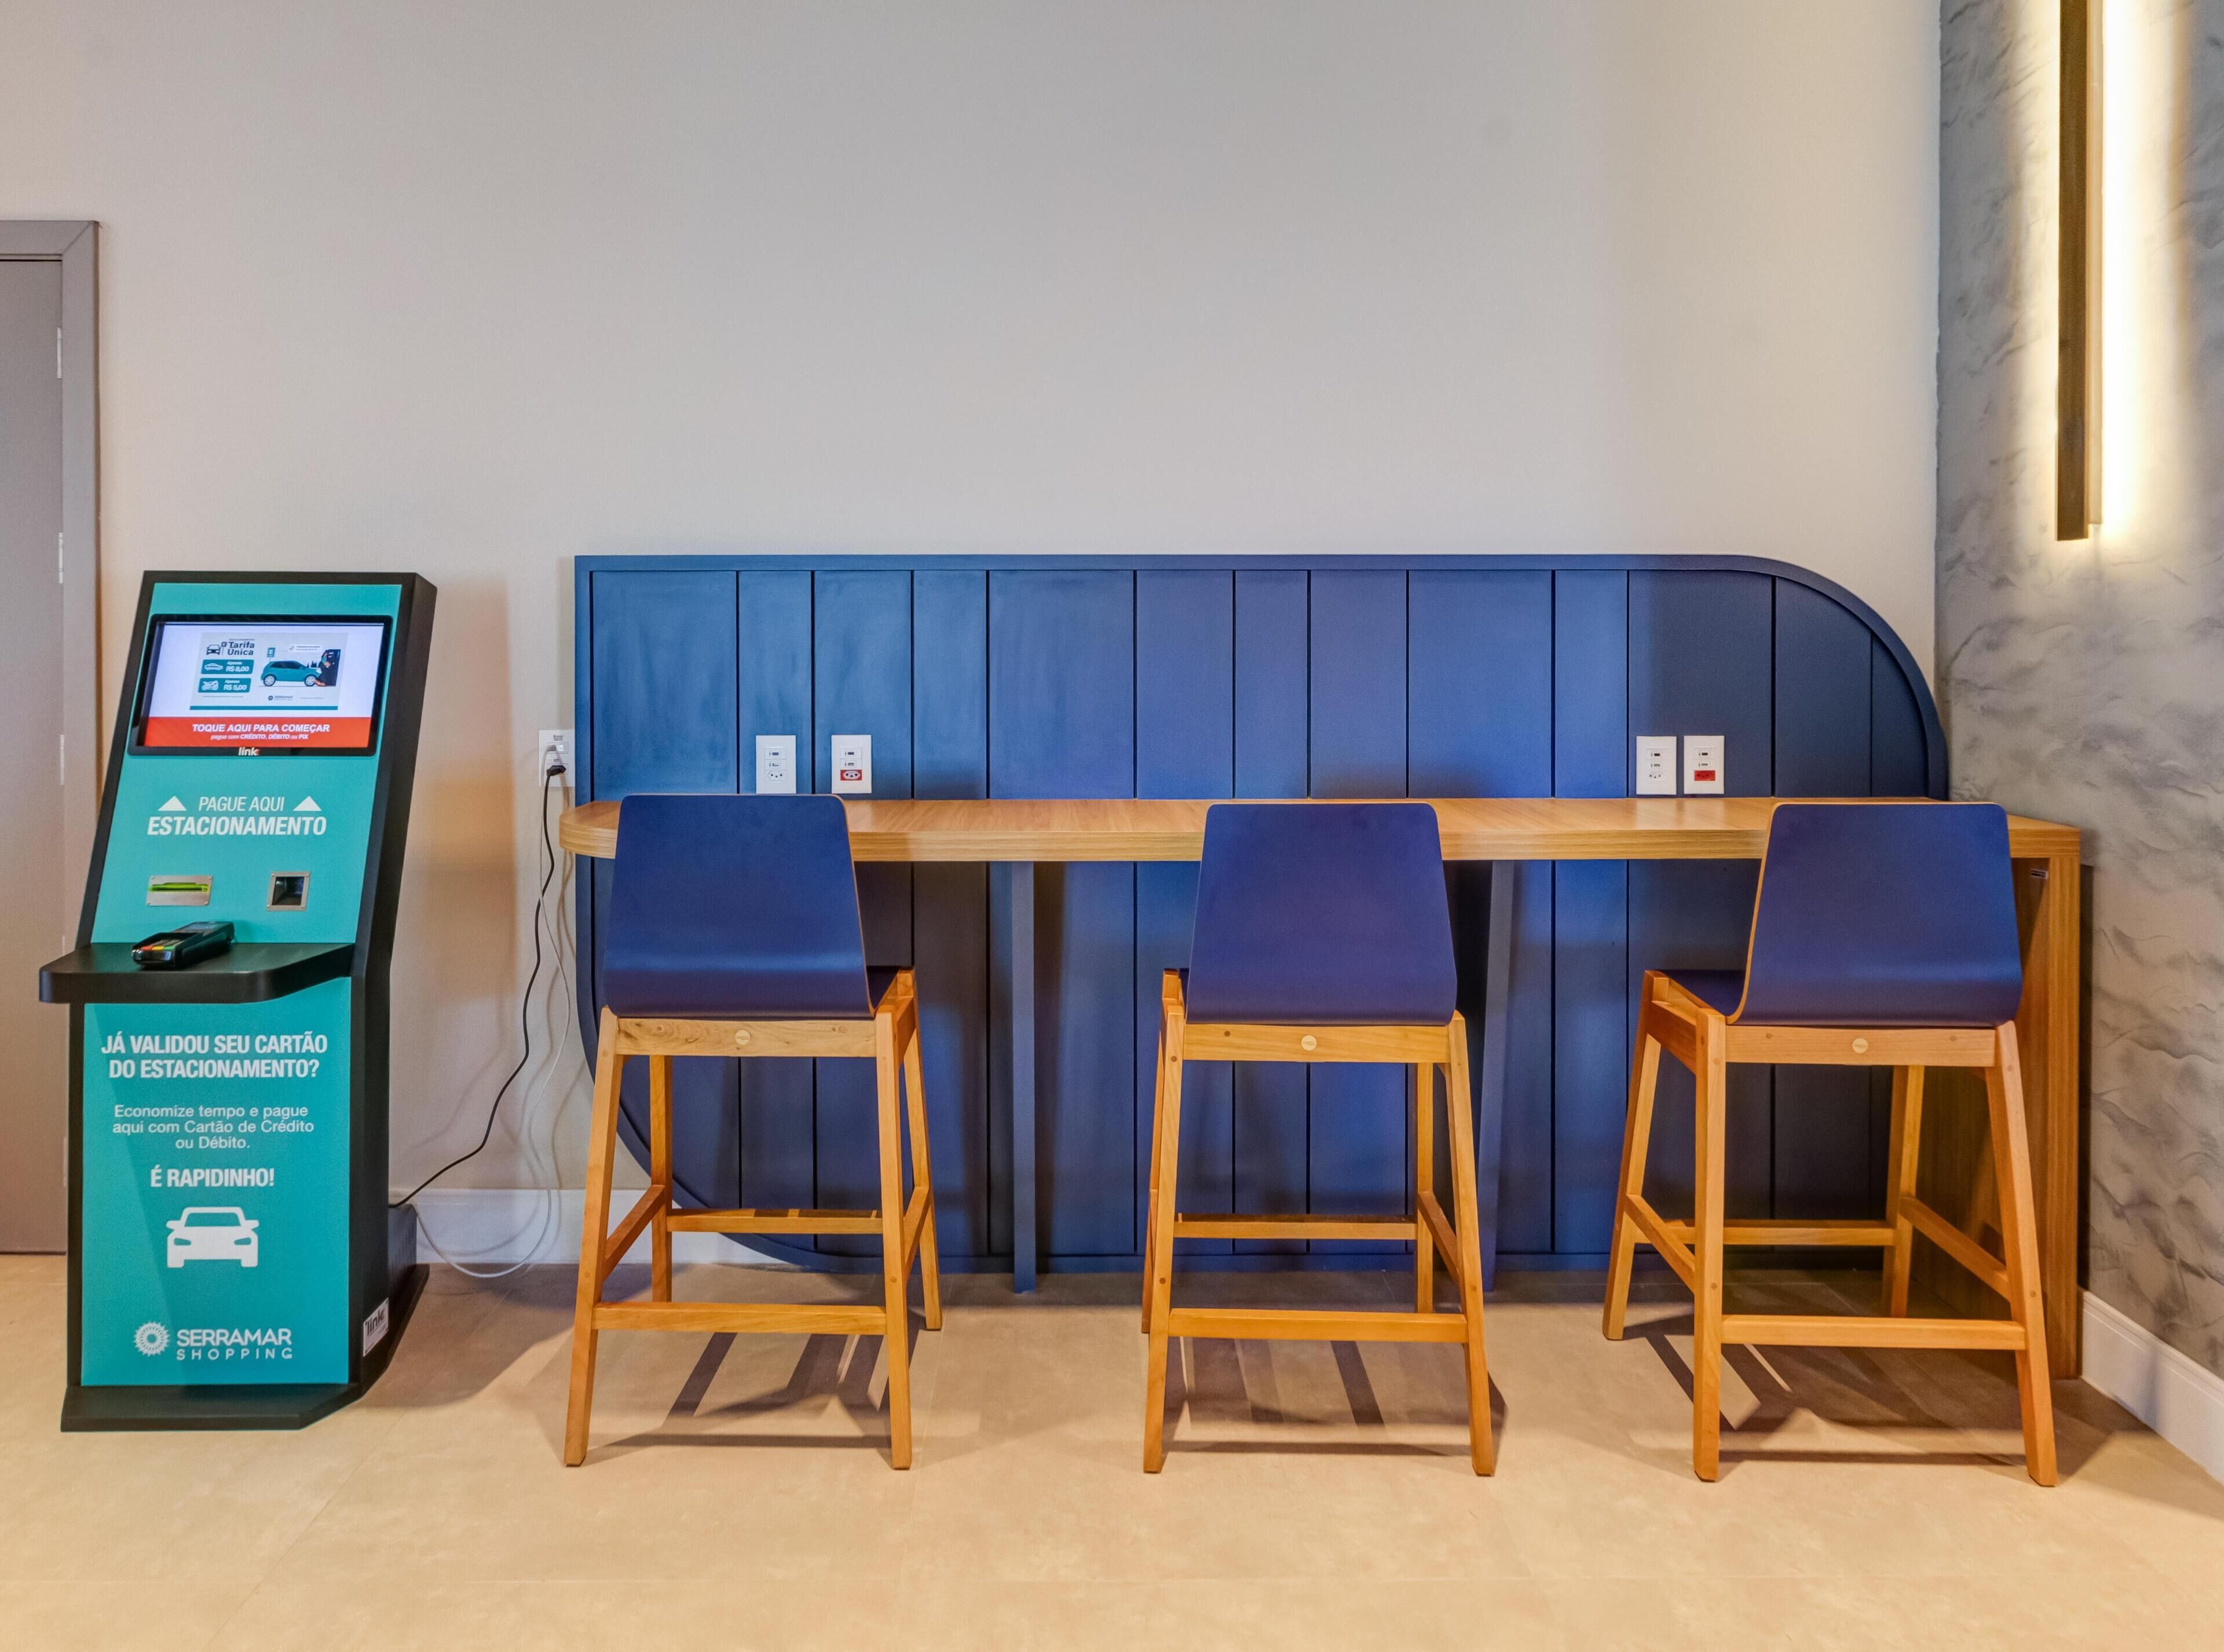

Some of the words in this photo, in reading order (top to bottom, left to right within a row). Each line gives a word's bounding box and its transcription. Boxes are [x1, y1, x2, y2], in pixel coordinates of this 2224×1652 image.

[192, 724, 225, 732] TOQUE
[227, 724, 251, 732] AQUI
[253, 724, 280, 732] PARA
[281, 724, 330, 734] COMEÇAR
[238, 747, 258, 756] link
[199, 796, 247, 811] PAGUE
[248, 796, 284, 812] AQUI
[147, 816, 327, 836] ESTACIONAMENTO
[101, 1031, 125, 1054] JÁ
[130, 1035, 209, 1054] VALIDOU
[214, 1035, 250, 1054] SEU
[255, 1031, 327, 1053] CARTÃO
[109, 1060, 136, 1078] DO
[140, 1059, 320, 1078] ESTACIONAMENTO?
[114, 1105, 194, 1118] Economize
[199, 1106, 244, 1120] tempo
[250, 1107, 258, 1117] e
[264, 1107, 308, 1120] pague
[112, 1121, 144, 1136] aqui
[148, 1123, 179, 1133] com
[184, 1120, 233, 1133] Cartão
[238, 1120, 257, 1133] de
[261, 1120, 314, 1133] Crédito
[175, 1139, 193, 1149] ou
[199, 1135, 250, 1149] Débito.
[150, 1164, 163, 1187] É
[167, 1168, 275, 1187] RAPIDINHO!
[177, 1328, 292, 1347] SERRAMAR
[176, 1347, 292, 1361] SHOPPING
